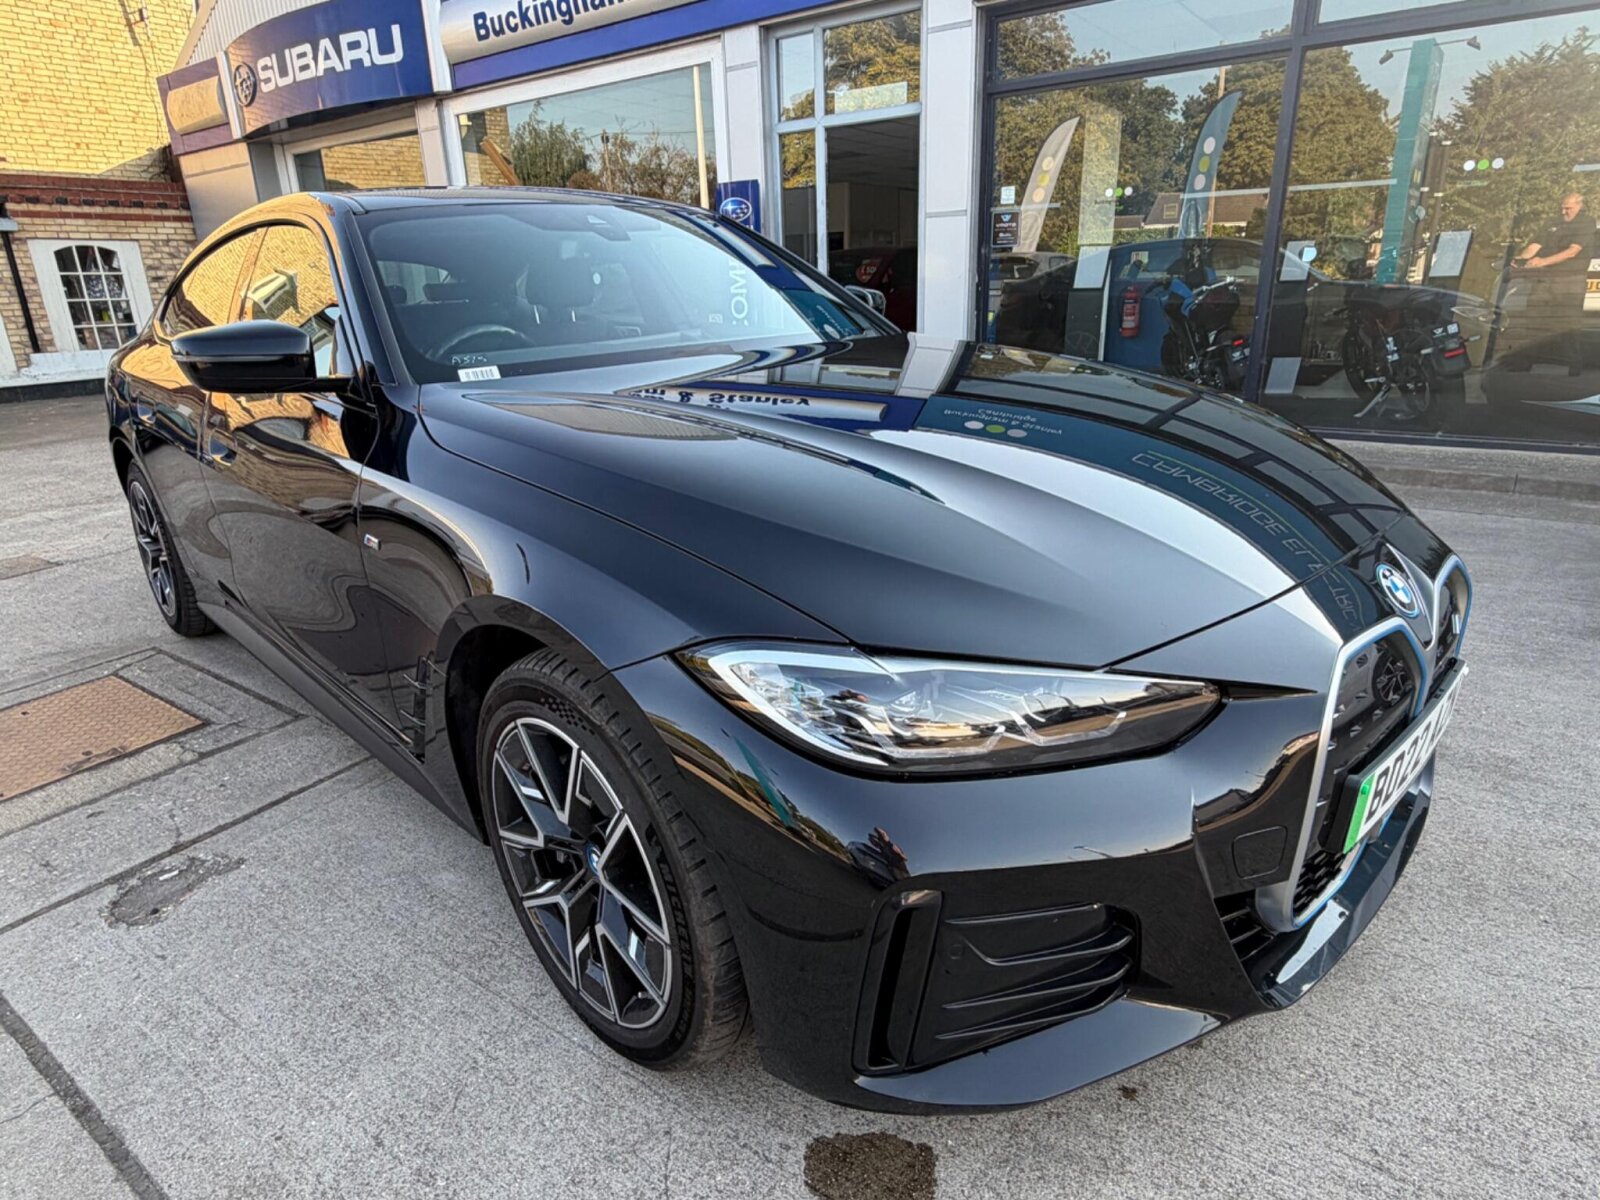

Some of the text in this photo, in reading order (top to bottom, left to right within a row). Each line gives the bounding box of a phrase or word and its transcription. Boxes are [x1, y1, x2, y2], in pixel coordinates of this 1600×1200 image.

[473, 0, 630, 41] Bucking
[257, 24, 404, 93] SUBARU
[657, 861, 695, 978] MICHELIN
